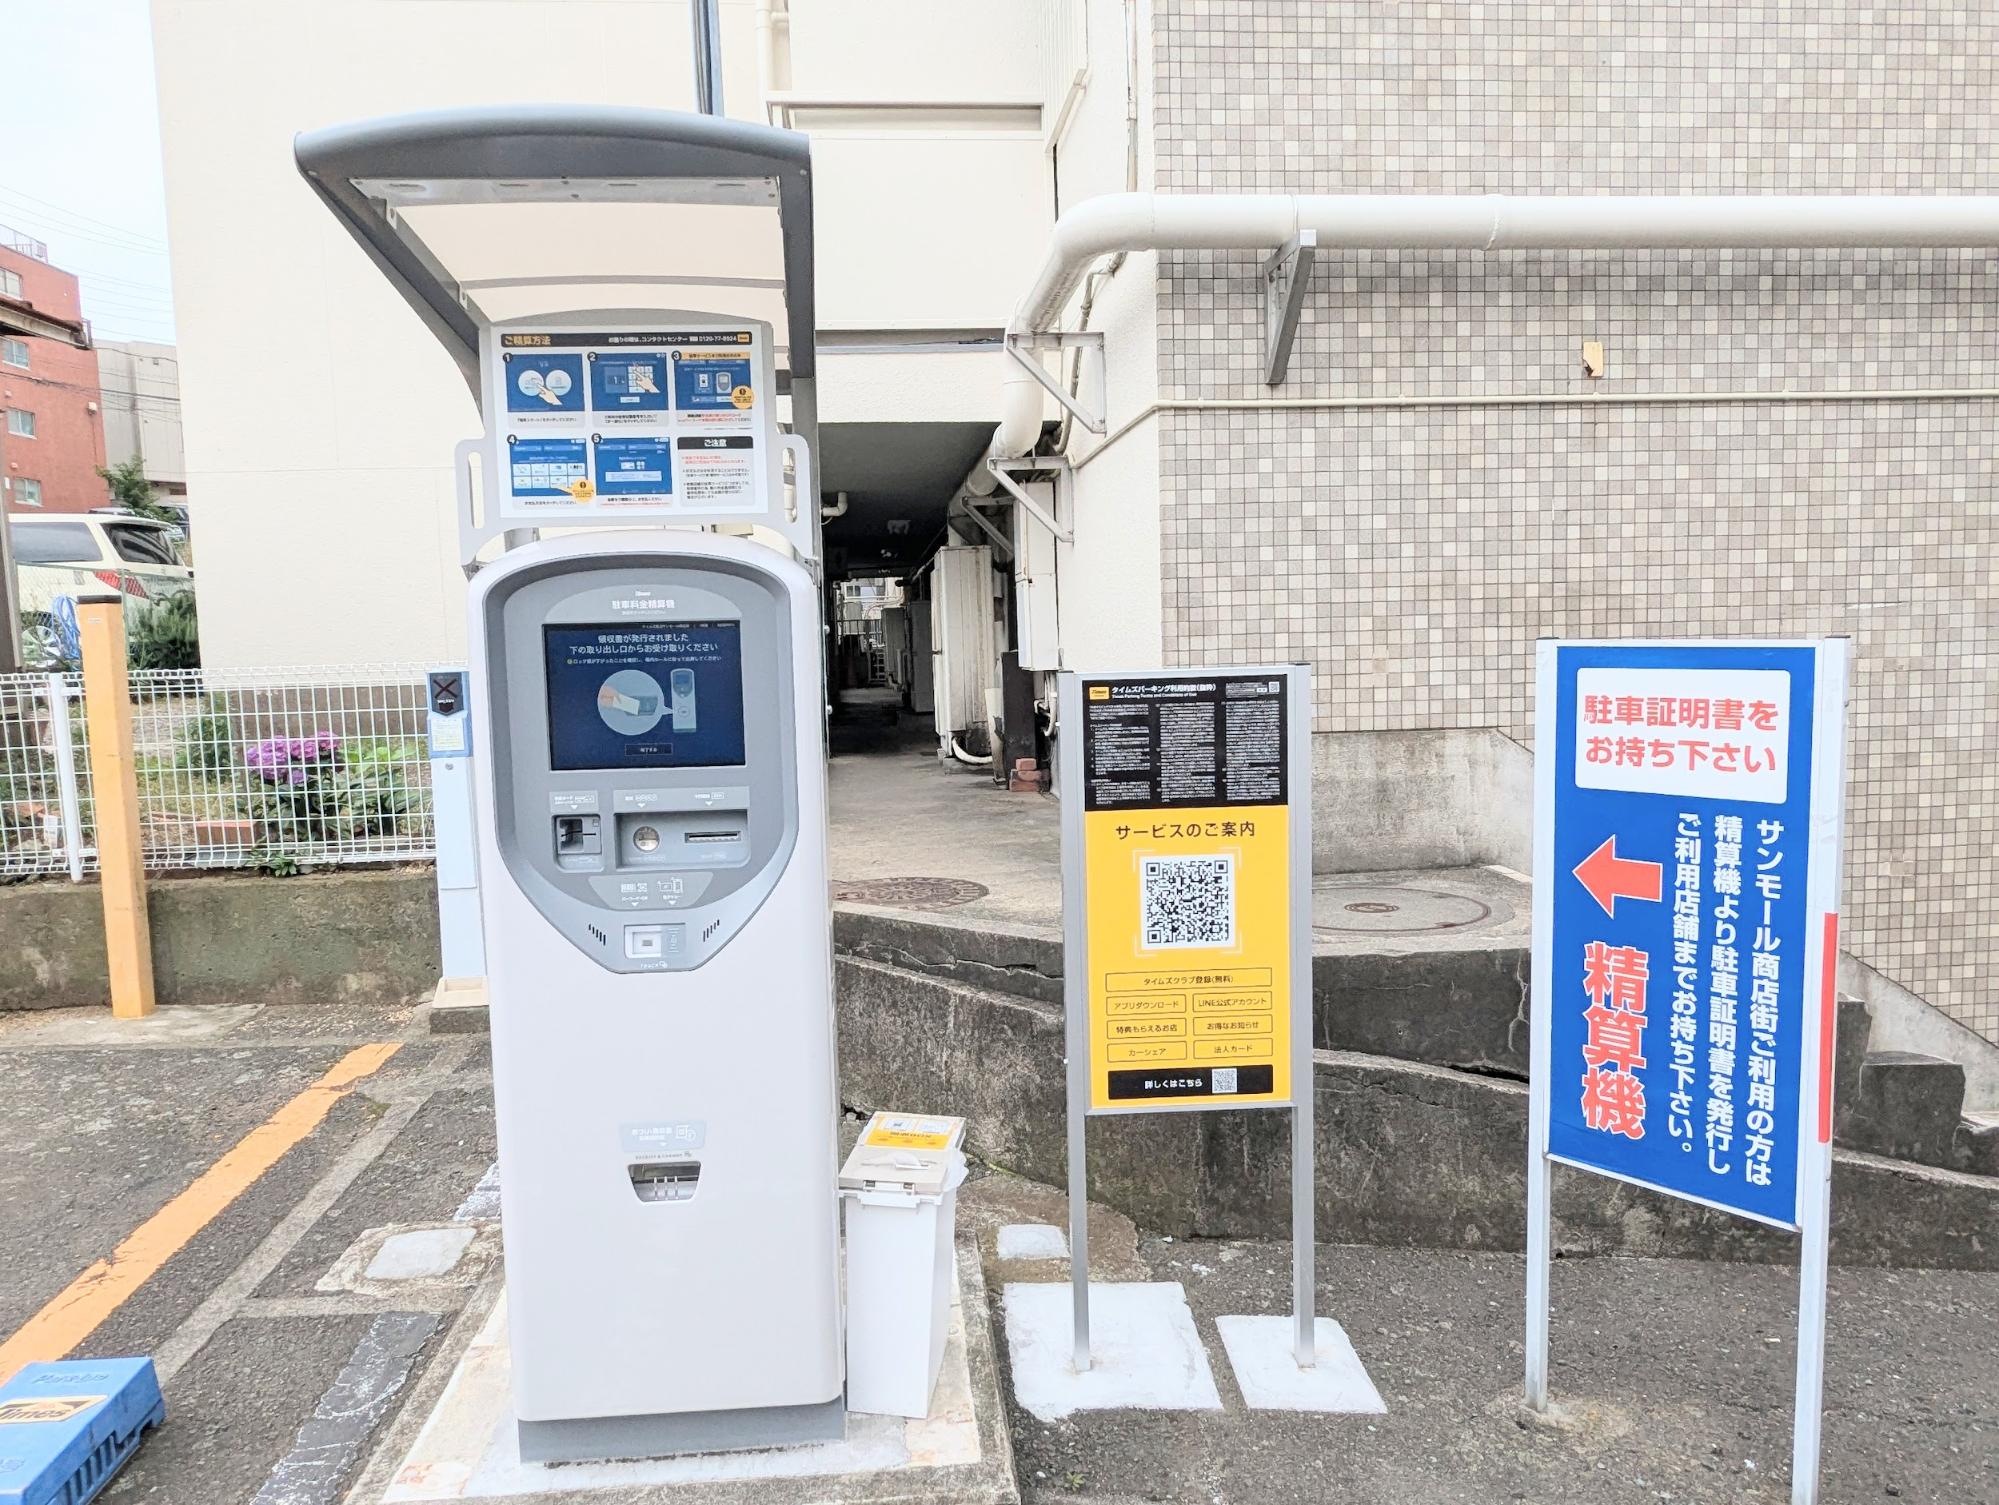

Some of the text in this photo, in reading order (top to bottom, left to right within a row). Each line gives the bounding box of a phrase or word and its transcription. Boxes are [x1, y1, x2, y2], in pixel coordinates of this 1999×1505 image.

[704, 439, 727, 447] ご注意
[612, 599, 675, 610] 駐車料金精算機
[598, 633, 689, 644] 領収書が発行されました
[569, 643, 719, 655] 下の取り出し口からお受け取りください
[1583, 694, 1779, 731] 駐車証明書を
[1585, 735, 1776, 773] お持ち下さい
[1115, 820, 1256, 840] サービスのご案内
[1143, 975, 1234, 986] タイムズクラブ登録(無料)
[1668, 811, 1702, 1154] ご利用店舗までお持ち下さい。
[1704, 814, 1743, 1176] 精算機より駐車証明書を発行し
[1114, 1000, 1179, 1010] アプリダウンロード
[1199, 997, 1267, 1007] LINE公式アカウント
[1744, 818, 1785, 1187] サンモール商店街ご利用の方は
[1116, 1023, 1178, 1034] 特典もらえるお店
[1206, 1020, 1260, 1030] お得なお知らせ
[1581, 940, 1650, 1141] 精算機
[1128, 1047, 1167, 1057] カーシェア
[1213, 1044, 1253, 1054] 法人カード
[1144, 1078, 1203, 1090] 詳しくはこちら
